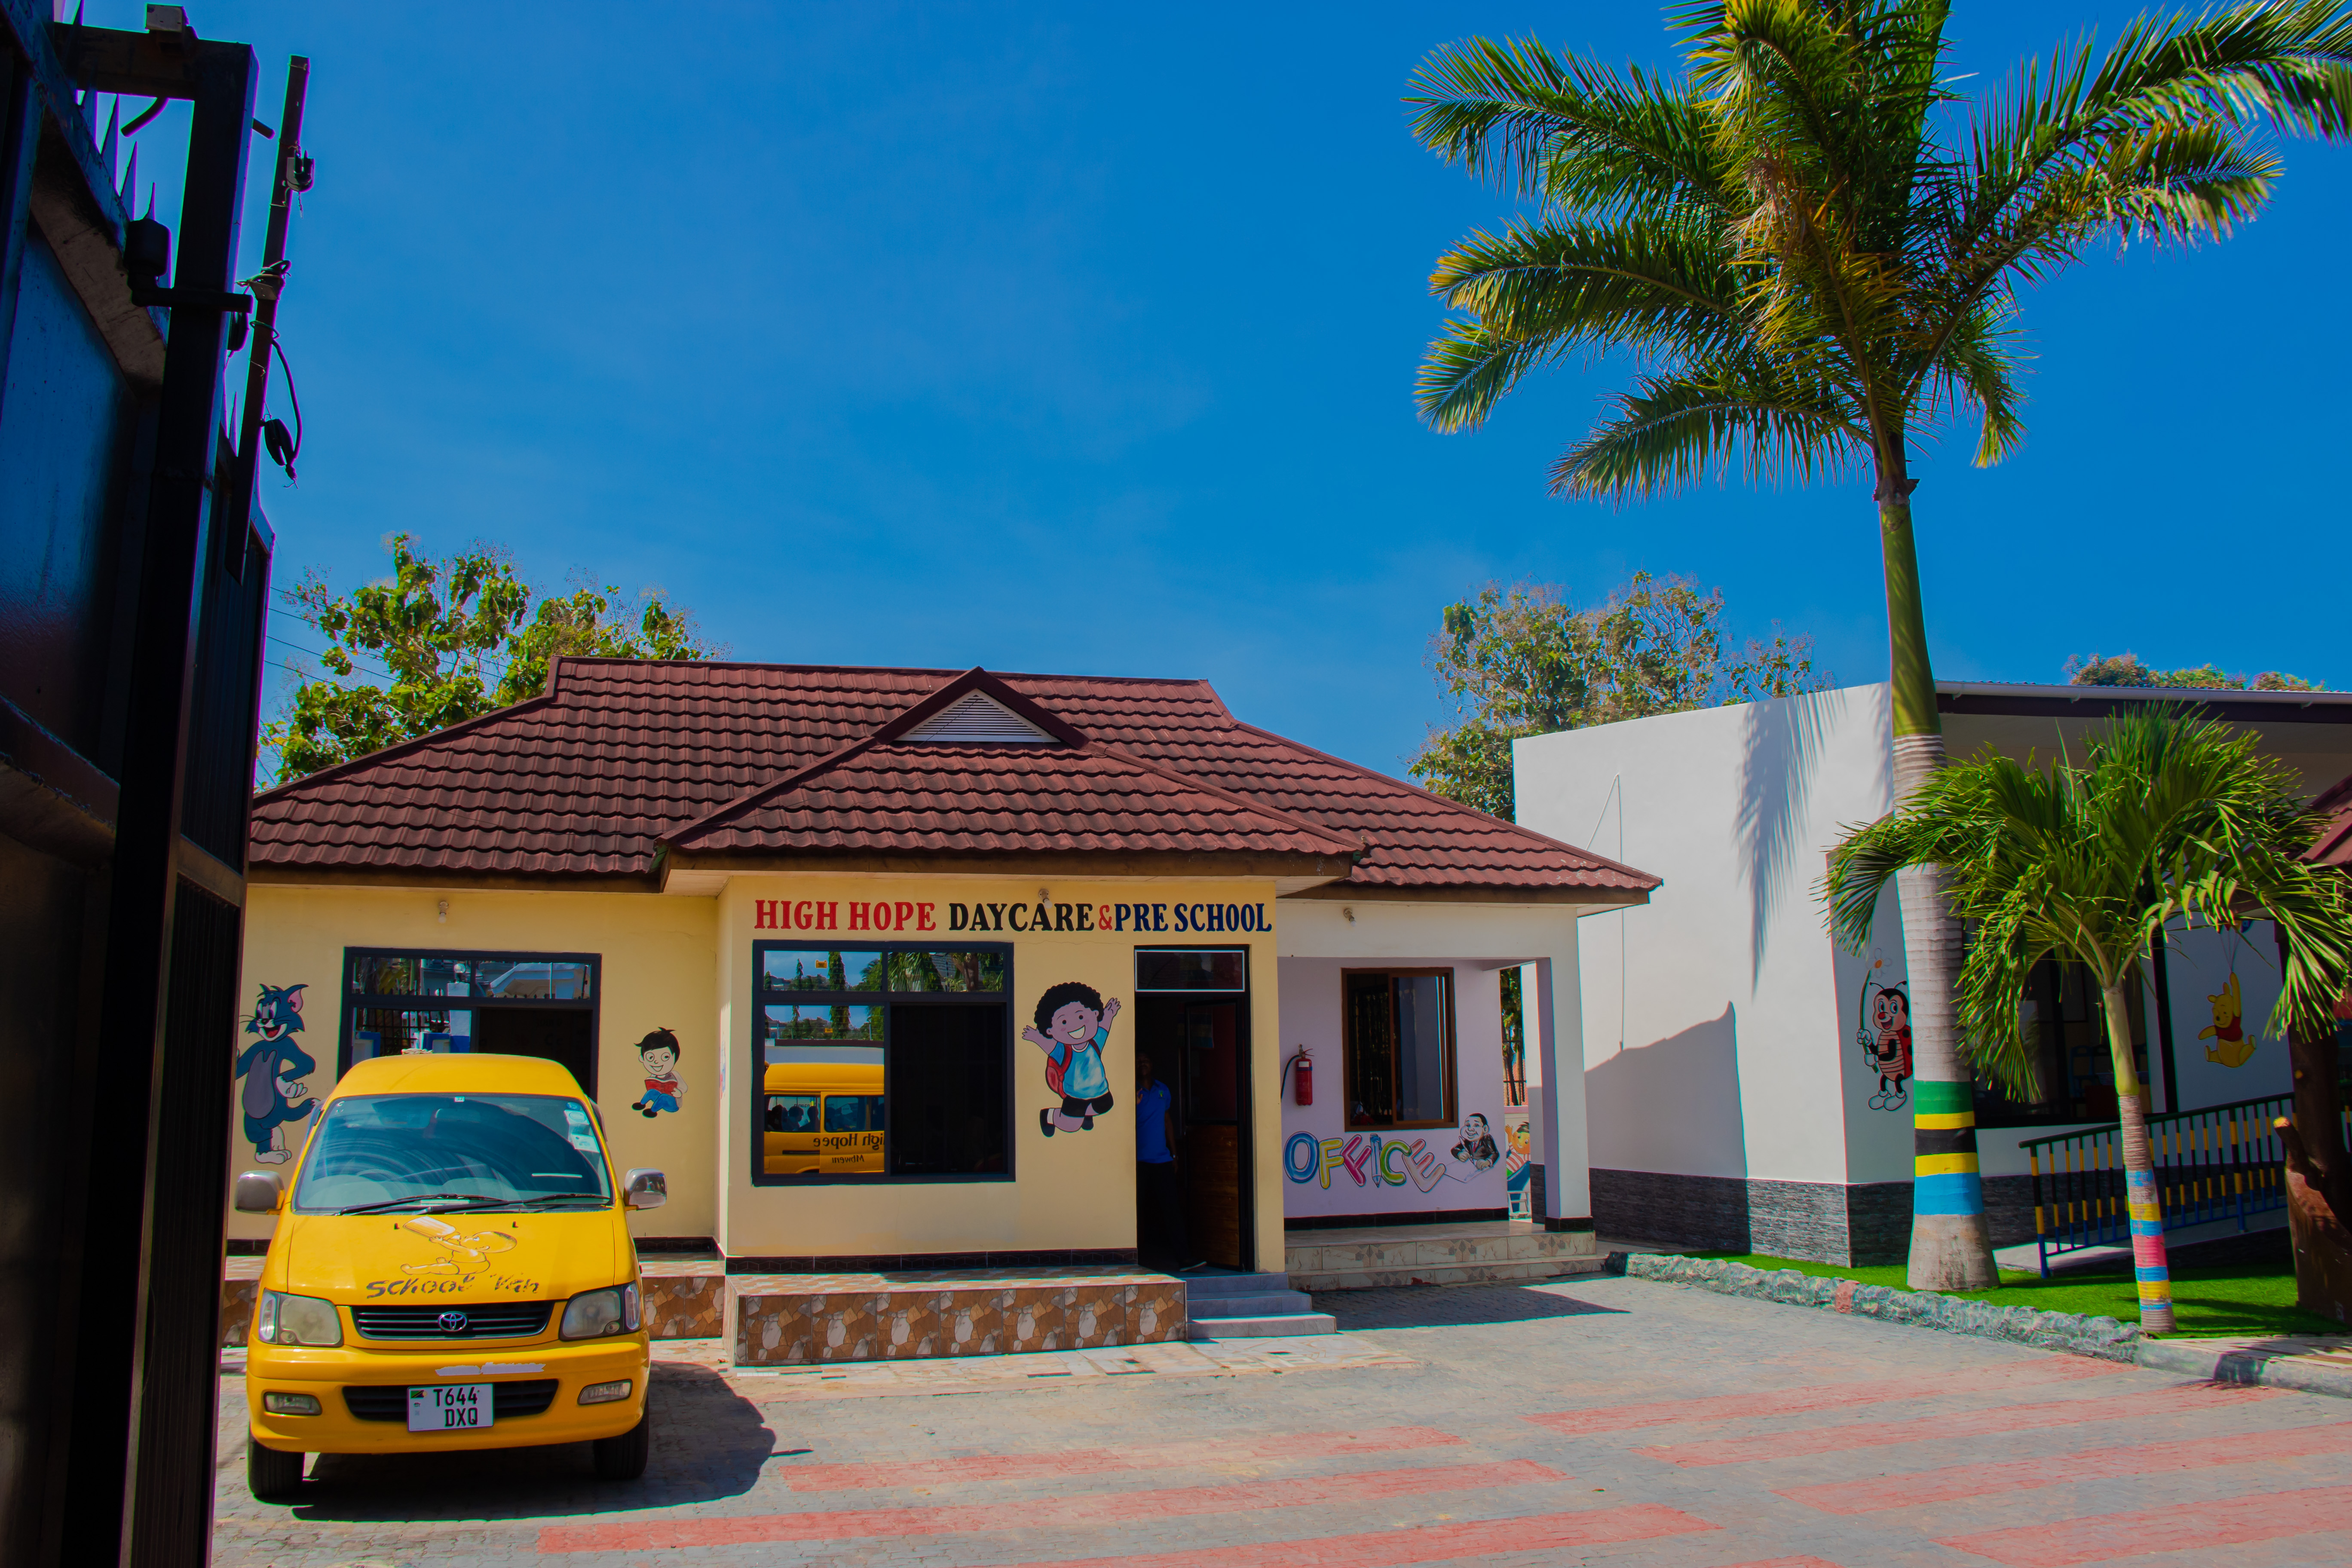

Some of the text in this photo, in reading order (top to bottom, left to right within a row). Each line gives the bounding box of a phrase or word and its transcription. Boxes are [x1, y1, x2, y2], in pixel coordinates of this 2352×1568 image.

[754, 899, 839, 930] HIGH
[847, 901, 937, 931] HOPE
[949, 902, 1095, 932] DAYCARE
[1174, 903, 1272, 932] SCHOOL
[1283, 1130, 1446, 1192] OFFICE
[433, 1386, 478, 1407] T644
[444, 1407, 478, 1427] DXQ
